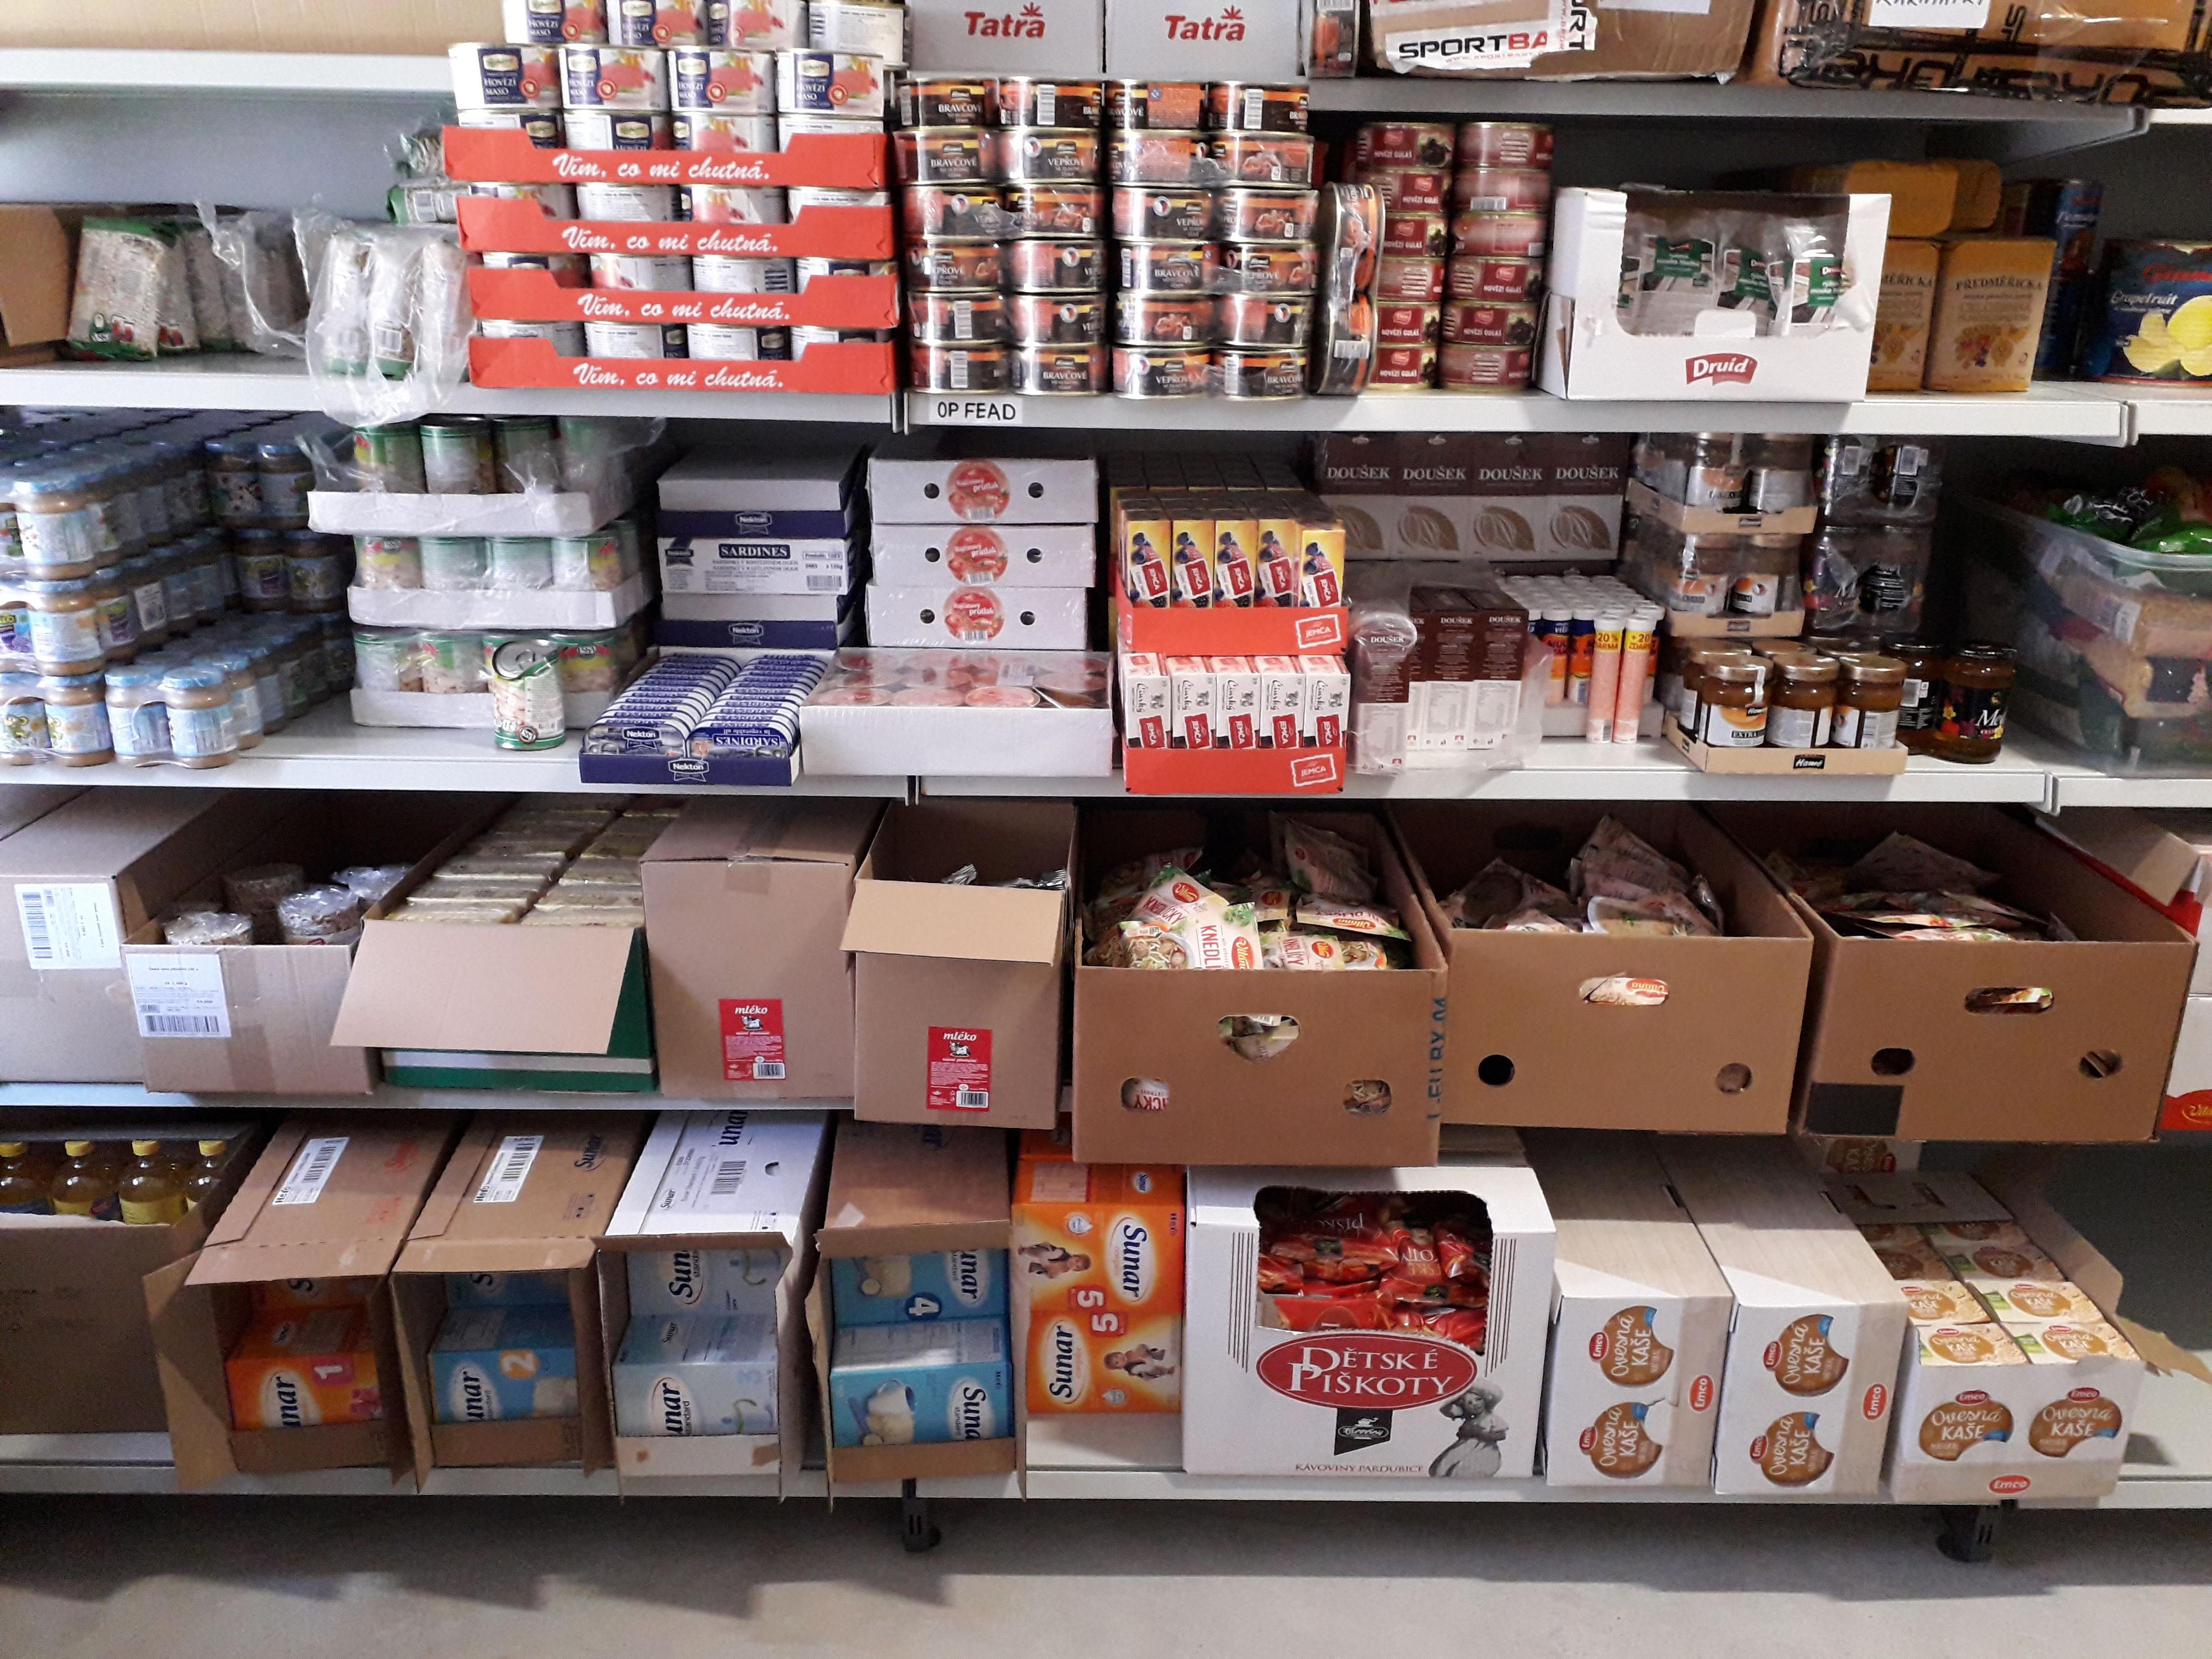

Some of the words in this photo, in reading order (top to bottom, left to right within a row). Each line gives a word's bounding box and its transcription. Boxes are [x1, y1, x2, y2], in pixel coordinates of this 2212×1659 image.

[965, 11, 1046, 38] Tatra
[1164, 14, 1245, 41] Tatra
[1399, 30, 1548, 59] SPORTBA
[484, 87, 509, 96] MASO
[617, 162, 641, 178] co
[649, 160, 680, 177] mi
[687, 156, 770, 180] chutná.
[626, 234, 650, 249] co
[658, 233, 690, 250] mi
[696, 229, 778, 252] chutná.
[640, 301, 665, 316] co
[672, 300, 703, 317] mi
[709, 298, 790, 320] chutná.
[635, 372, 659, 386] co
[667, 370, 697, 386] mi
[703, 366, 784, 388] chutná.
[1693, 356, 1750, 378] Druid
[964, 401, 1016, 421] FEAD
[1328, 464, 1390, 480] DOUŠEK
[1402, 465, 1467, 481] DOUŠEK
[1478, 466, 1543, 481] DOUŠEK
[1556, 465, 1620, 480] DOUŠEK
[720, 546, 788, 558] SARDINES
[1148, 567, 1161, 591] JEMCA
[1191, 566, 1202, 590] JEMCA
[1234, 566, 1244, 590] JEMCA
[1319, 578, 1330, 601] JEMCA
[968, 607, 994, 617] protlak
[1305, 626, 1332, 638] JEMCA
[626, 730, 656, 739] Nekton
[715, 735, 780, 746] SARDINES
[1146, 722, 1157, 745] JEMCA
[1191, 721, 1201, 744] JEMCA
[1234, 721, 1244, 744] JEMCA
[1278, 721, 1287, 744] JEMCA
[1322, 721, 1332, 744] JEMCA
[672, 763, 705, 771] Nekton
[1301, 765, 1327, 778] JEMCA
[734, 1005, 768, 1015] mléko
[942, 1031, 977, 1042] mléko
[719, 1110, 748, 1146] unar
[660, 1190, 676, 1210] Sunar
[1123, 1224, 1147, 1299] Sunar
[670, 1250, 691, 1298] Sun
[960, 1251, 978, 1299] unar
[909, 1297, 940, 1316] 4
[1077, 1290, 1104, 1308] 5
[1091, 1313, 1119, 1332] 5
[1593, 1333, 1604, 1358] Emco
[1611, 1313, 1634, 1377] Ovesná
[1631, 1328, 1652, 1368] KAŠE
[1767, 1344, 1778, 1366] Emco
[1783, 1322, 1808, 1385] Ovesná
[1803, 1336, 1825, 1375] KAŠE
[314, 1364, 343, 1379] 1
[501, 1352, 536, 1372] 2
[1049, 1325, 1073, 1399] Sunar
[1300, 1347, 1439, 1373] DĚTSKÉ
[1286, 1361, 1454, 1396] PIŠKOTY
[276, 1376, 301, 1428] unar
[465, 1370, 484, 1422] unar
[1695, 1379, 1707, 1409] Emco
[1868, 1386, 1882, 1417] Emco
[1959, 1392, 1985, 1402] Emco
[2070, 1389, 2096, 1399] Emco
[663, 1381, 684, 1434] unar
[1931, 1407, 2003, 1426] Ovesná
[2042, 1406, 2112, 1421] Ovesná
[1599, 1405, 1623, 1467] Ovesná
[1619, 1421, 1640, 1457] KAŠE
[1941, 1423, 1985, 1441] KAŠE
[2051, 1420, 2094, 1437] KAŠE
[1769, 1415, 1794, 1476] Ovesná
[1790, 1428, 1811, 1466] KAŠE
[1358, 1463, 1425, 1473] PARDUBICE
[1994, 1478, 2027, 1490] Emco
